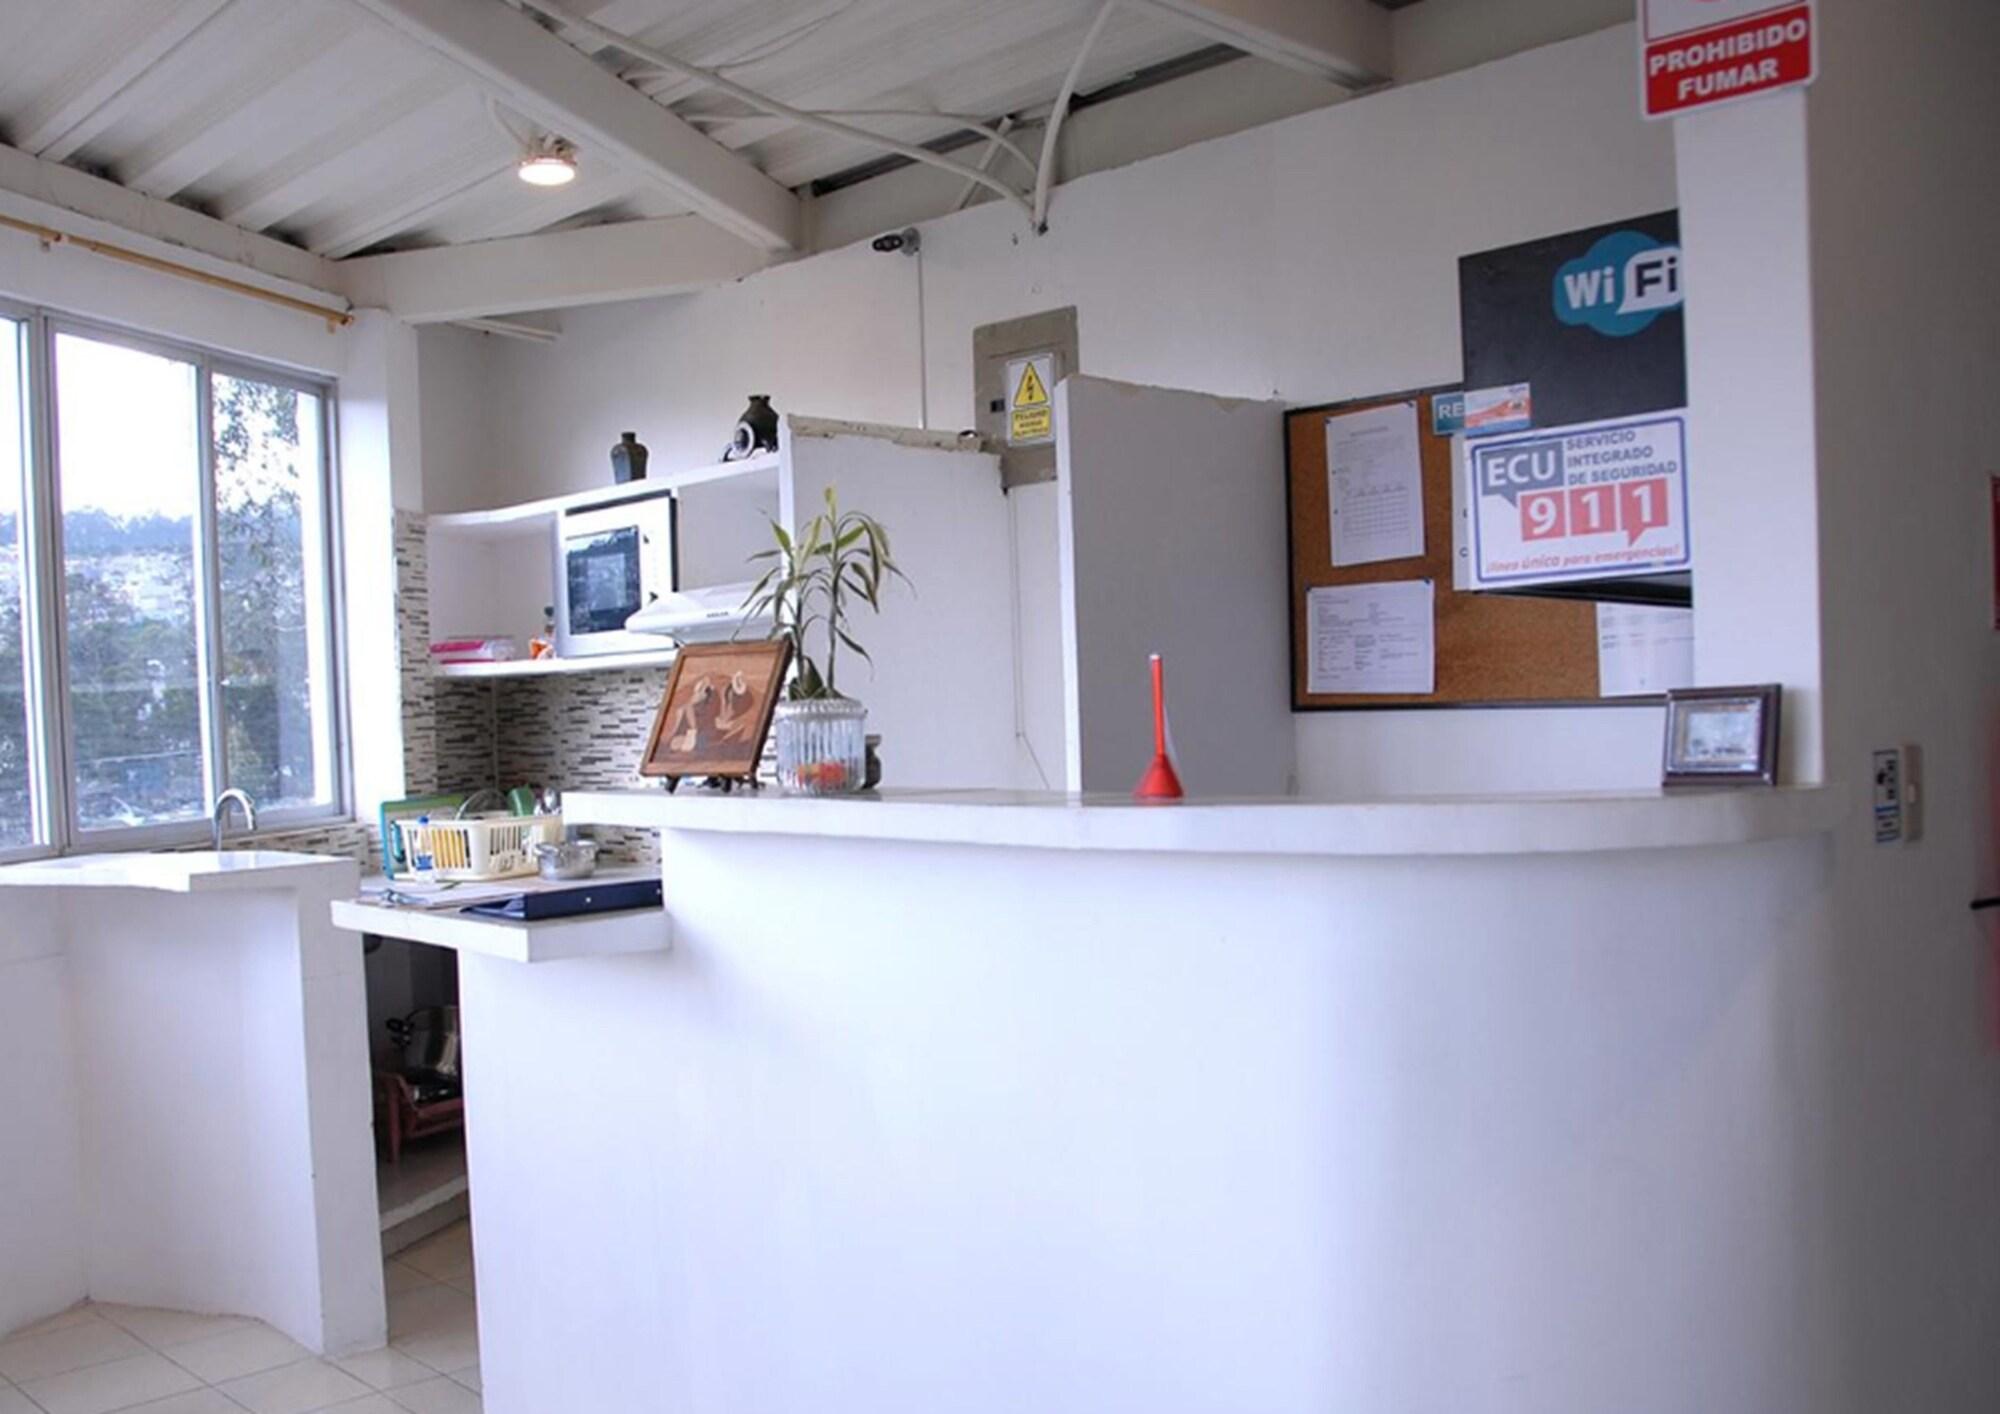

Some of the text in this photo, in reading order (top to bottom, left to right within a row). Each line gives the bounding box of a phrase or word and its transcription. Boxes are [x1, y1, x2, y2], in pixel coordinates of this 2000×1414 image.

[1649, 18, 1807, 77] PROHIBIDO
[1677, 58, 1779, 100] FUMAR
[1567, 430, 1636, 451] SERVICIO
[1567, 445, 1654, 468] INTEGRADO
[1487, 450, 1556, 487] ECU
[1568, 460, 1678, 485] DE SEGURIDAD
[1528, 484, 1655, 536] 911
